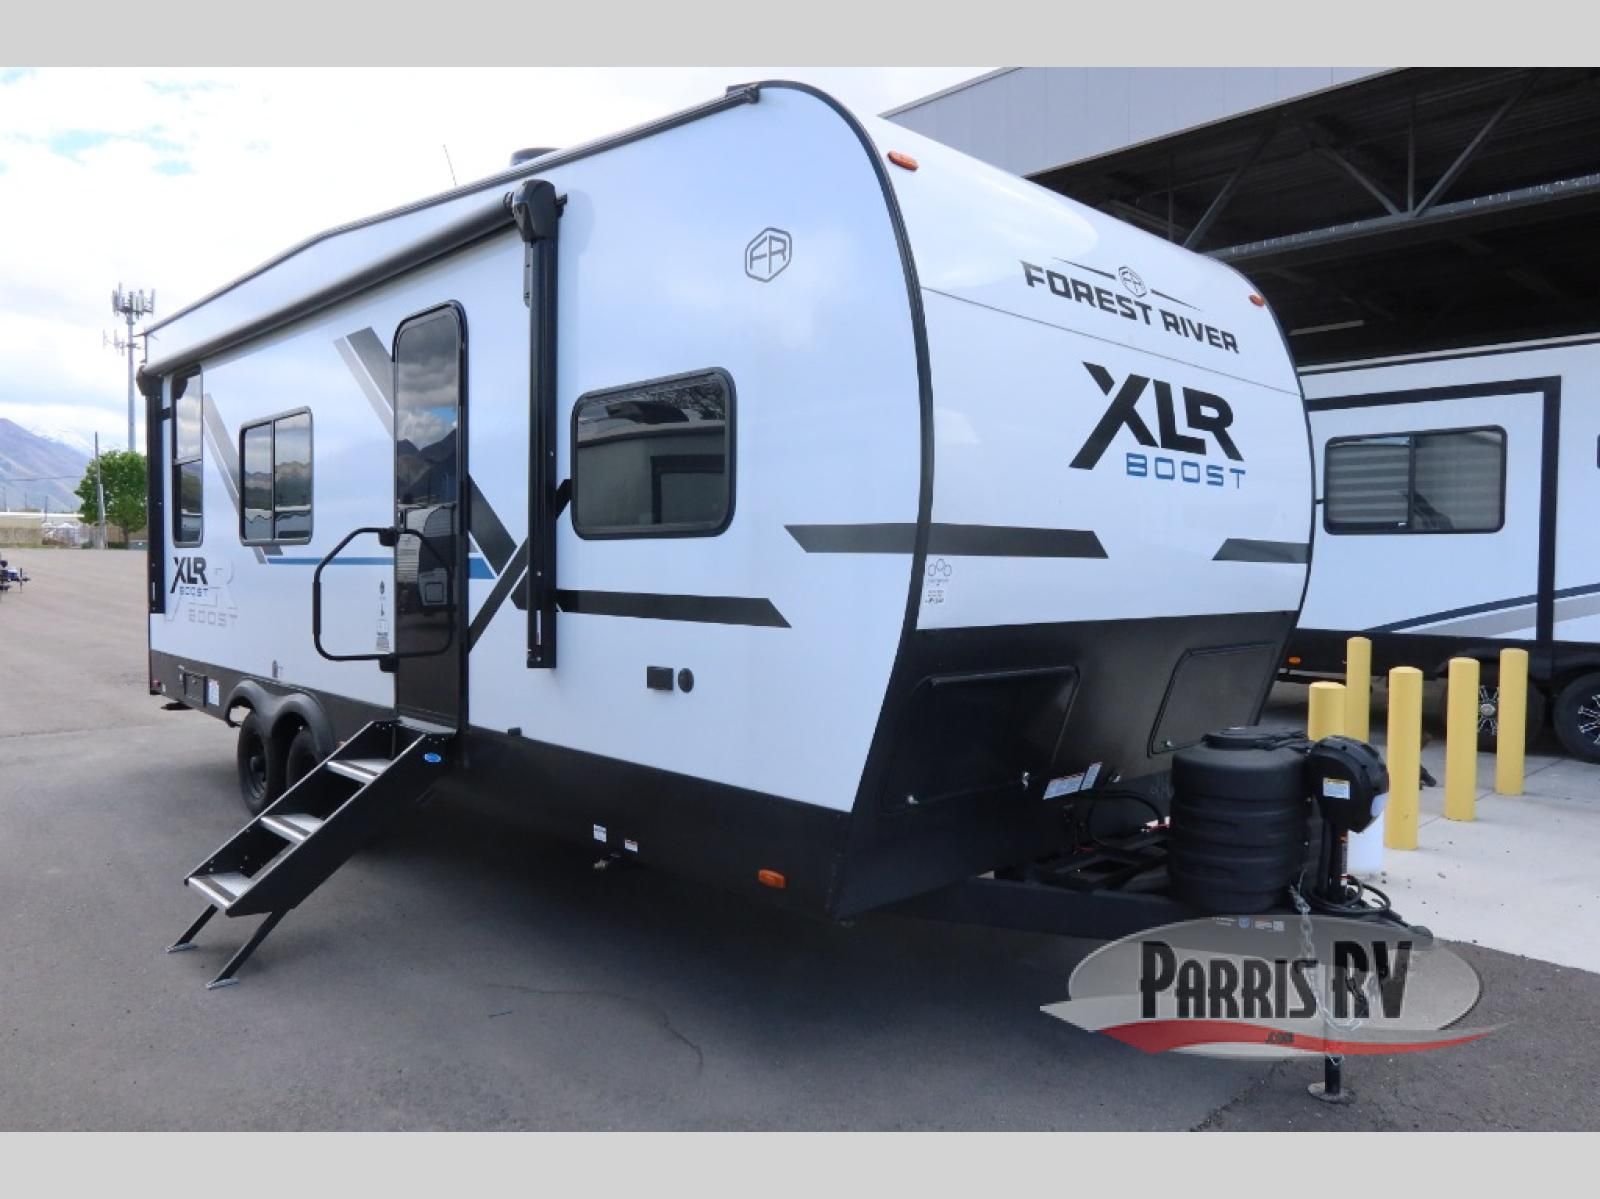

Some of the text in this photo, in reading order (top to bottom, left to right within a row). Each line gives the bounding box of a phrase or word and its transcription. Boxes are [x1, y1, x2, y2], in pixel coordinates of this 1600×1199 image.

[1020, 260, 1240, 353] FOREST RIVER
[1068, 361, 1244, 471] XLR
[1126, 452, 1246, 489] BOOST
[170, 556, 209, 594] XLR
[179, 586, 209, 597] BOOST
[188, 608, 239, 629] BOOST
